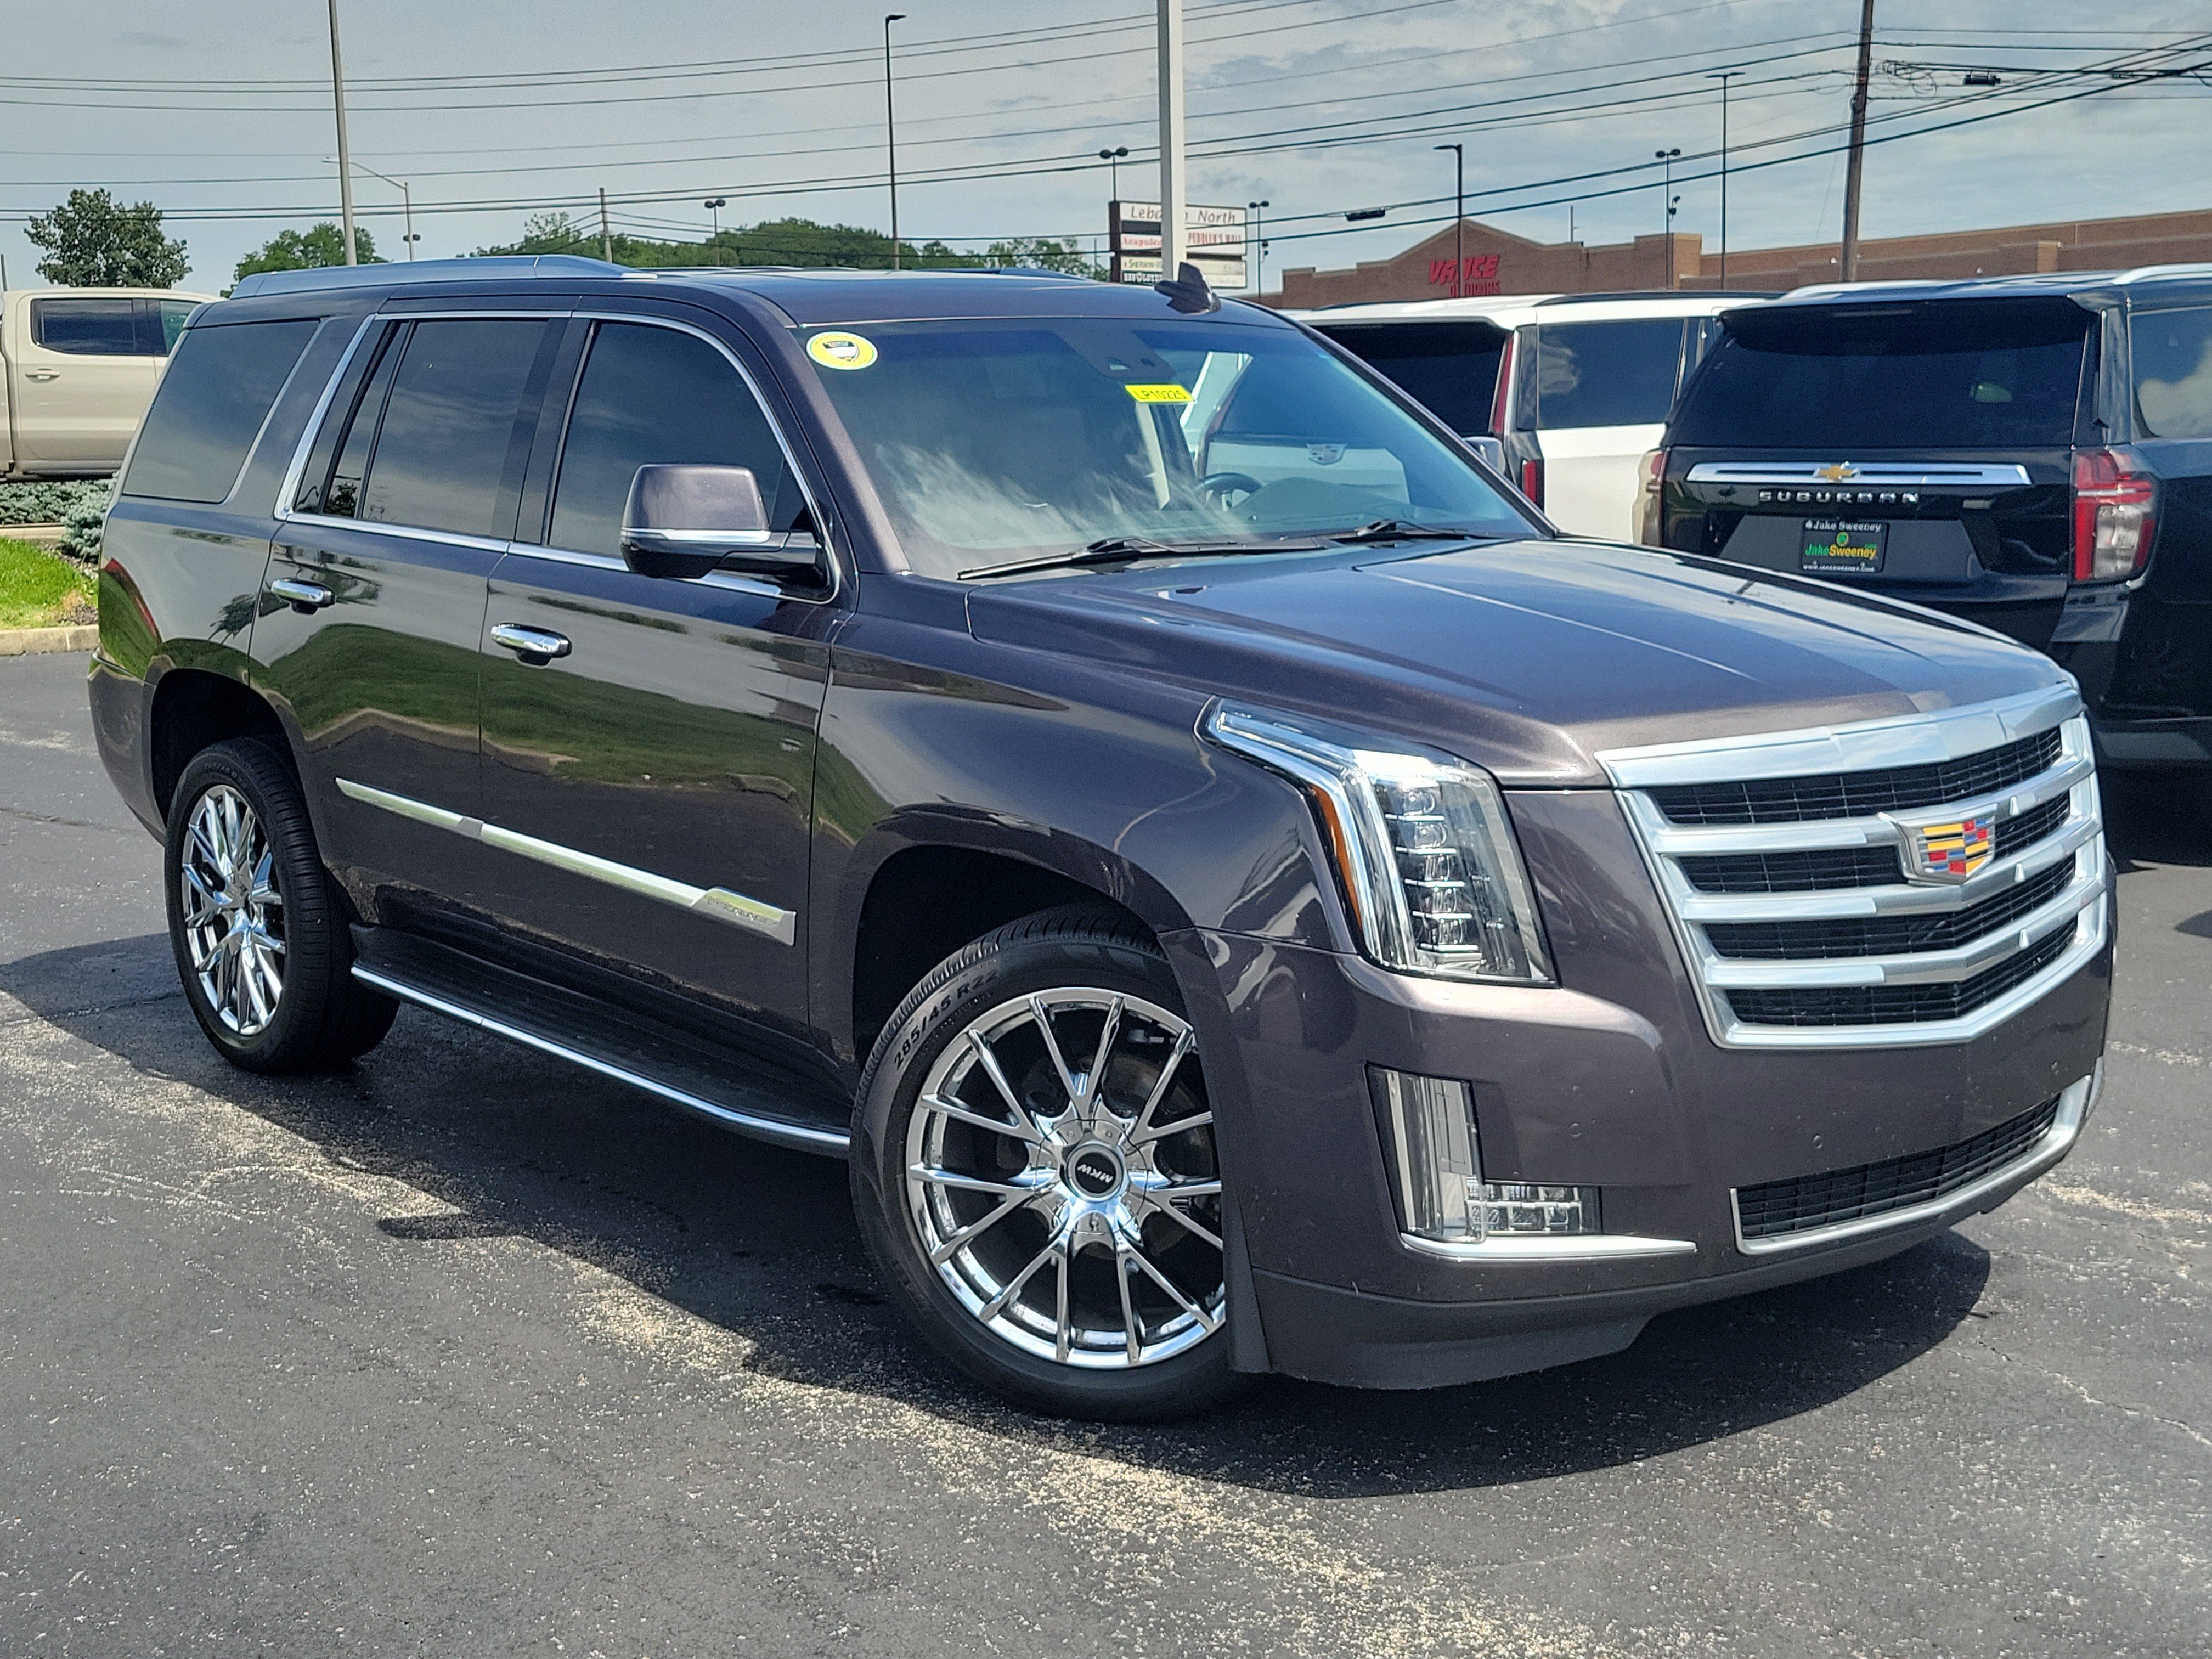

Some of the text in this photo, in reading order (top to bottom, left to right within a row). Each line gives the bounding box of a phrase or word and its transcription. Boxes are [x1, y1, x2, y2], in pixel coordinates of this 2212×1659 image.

[1198, 210, 1235, 224] North
[1430, 255, 1499, 284] VANCE
[1759, 490, 1919, 505] SUBURBAN
[1813, 520, 1881, 533] Jake Sweeney
[894, 995, 952, 1069] 285/45
[1077, 1164, 1114, 1183] MKW
